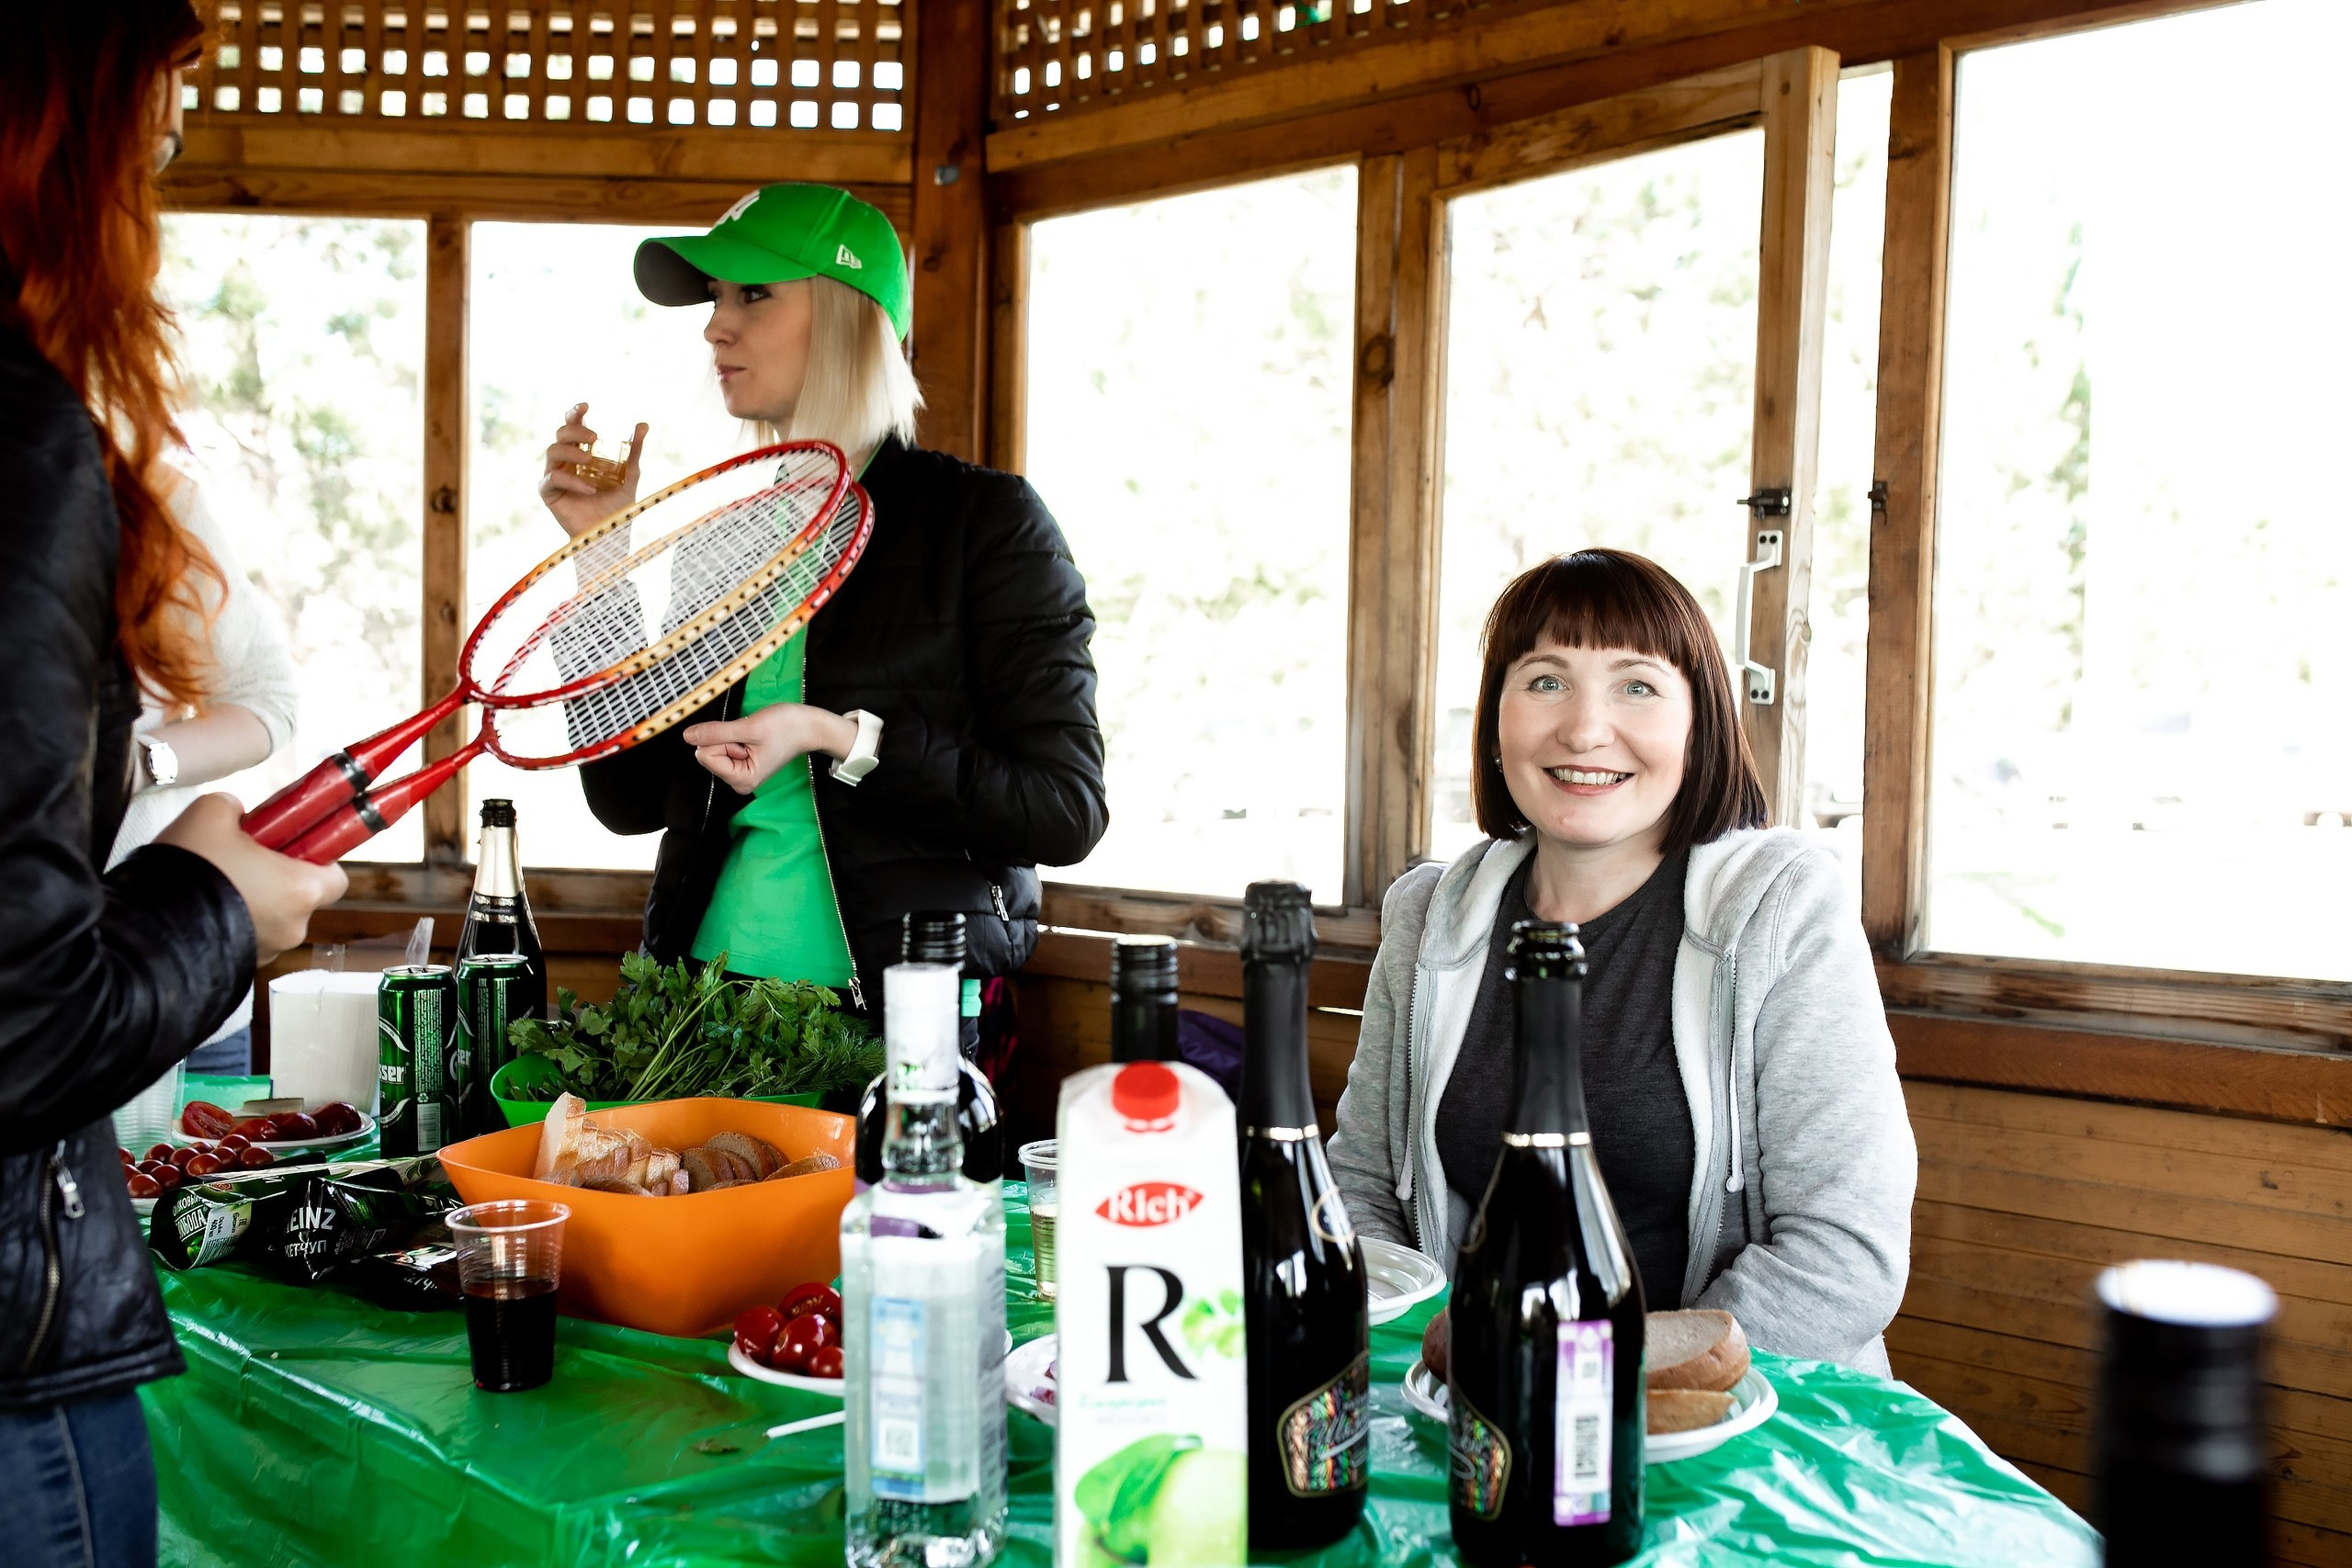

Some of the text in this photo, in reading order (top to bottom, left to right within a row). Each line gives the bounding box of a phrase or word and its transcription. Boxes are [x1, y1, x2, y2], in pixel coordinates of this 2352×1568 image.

[458, 1048, 471, 1066] er
[1107, 1188, 1191, 1223] Rich
[284, 1206, 336, 1234] EINZ
[285, 1240, 327, 1258] КЕТЧУП
[1105, 1265, 1197, 1383] R
